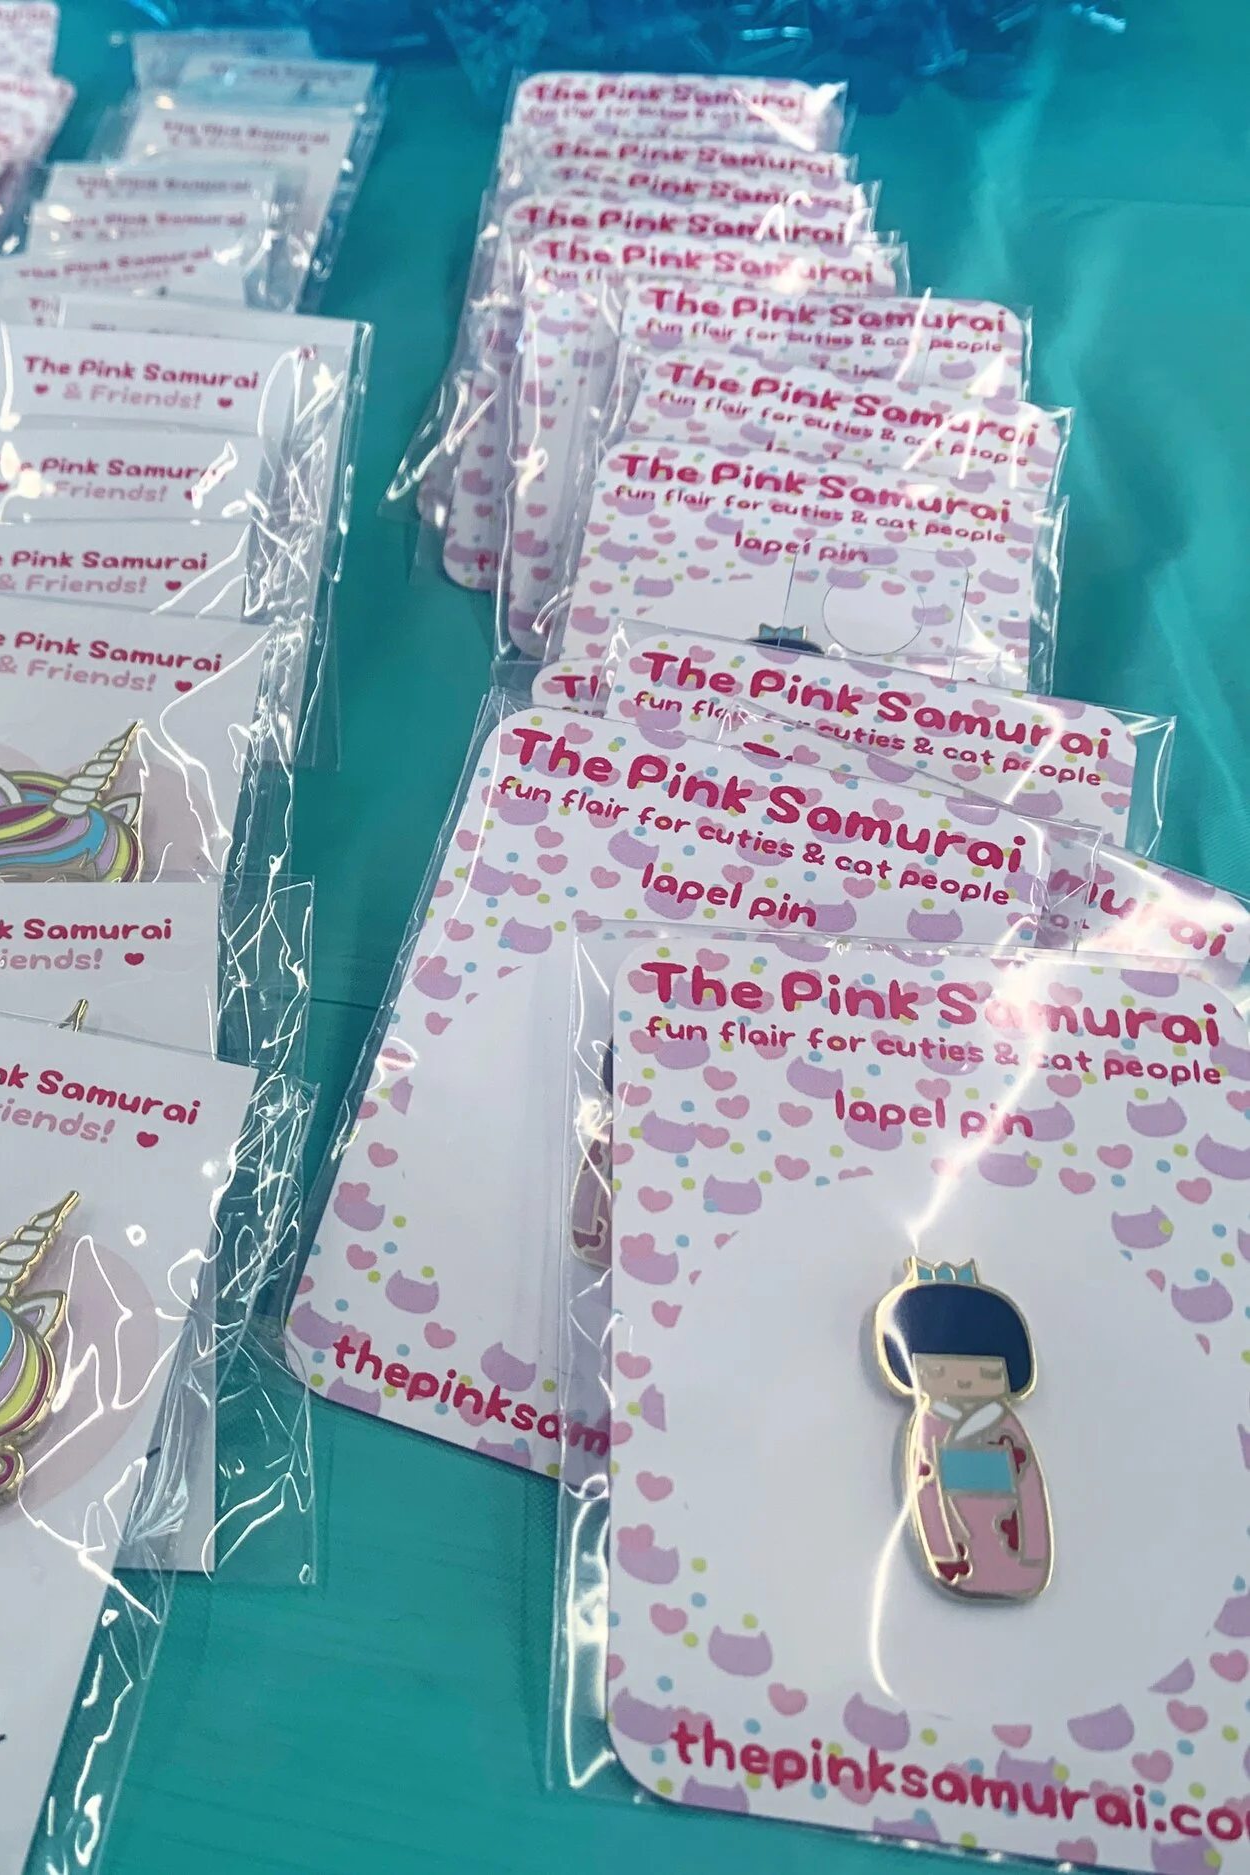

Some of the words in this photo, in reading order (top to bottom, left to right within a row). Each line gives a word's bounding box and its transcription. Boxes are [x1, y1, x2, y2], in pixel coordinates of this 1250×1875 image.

[650, 288, 718, 315] The
[733, 295, 815, 325] Pink
[829, 305, 1007, 334] Samurai
[788, 332, 854, 348] cuties
[861, 335, 875, 348] &
[928, 337, 1003, 353] people
[24, 356, 72, 376] The
[79, 361, 135, 379] Pink
[143, 365, 260, 389] Samurai
[63, 383, 81, 400] &
[89, 386, 203, 408] Friends!
[668, 363, 740, 396] The
[751, 378, 841, 411] Pink
[658, 391, 697, 410] fun
[704, 399, 751, 418] flair
[761, 407, 797, 424] for
[804, 414, 875, 437] cuties
[881, 427, 896, 440] &
[618, 455, 699, 483] The
[712, 463, 806, 495] Pink
[819, 474, 1012, 523] Samurai
[614, 484, 655, 501] fun
[665, 487, 716, 506] flair
[725, 494, 762, 512] for
[770, 501, 843, 522] cuties
[851, 510, 867, 523] &
[876, 514, 918, 531] cat
[925, 520, 1007, 544] people
[12, 552, 73, 567] Pink
[82, 553, 208, 571] Samurai
[818, 544, 869, 563] pin
[26, 576, 148, 593] Friends!
[15, 633, 80, 655] Pink
[89, 640, 223, 673] Samurai
[28, 662, 158, 690] Friends!
[633, 690, 682, 713] fun
[913, 736, 934, 754] &
[942, 744, 994, 766] cat
[642, 652, 736, 694] The
[750, 670, 863, 713] Pink
[877, 690, 1113, 760] Samurai
[513, 728, 613, 781] The
[627, 753, 753, 812] Pink
[767, 786, 1028, 873] Samurai
[497, 775, 551, 803] fun
[560, 792, 628, 821] flair
[638, 807, 688, 833] for
[697, 820, 793, 859] cuties
[802, 844, 825, 866] &
[834, 855, 890, 879] cat
[900, 867, 1011, 906] people
[642, 864, 741, 909] lapel
[748, 894, 817, 928] pin
[23, 918, 172, 939] Samurai
[642, 961, 762, 1011] The
[781, 973, 918, 1021] Pink
[646, 1019, 708, 1042] fun
[719, 1019, 796, 1050] flair
[808, 1027, 865, 1054] for
[875, 1034, 984, 1066] cuties
[995, 1042, 1017, 1066] &
[1104, 1058, 1223, 1086] people
[38, 1070, 201, 1126] Samurai
[836, 1089, 947, 1129] lapel
[669, 1720, 1250, 1842] thepinksamurai.co
